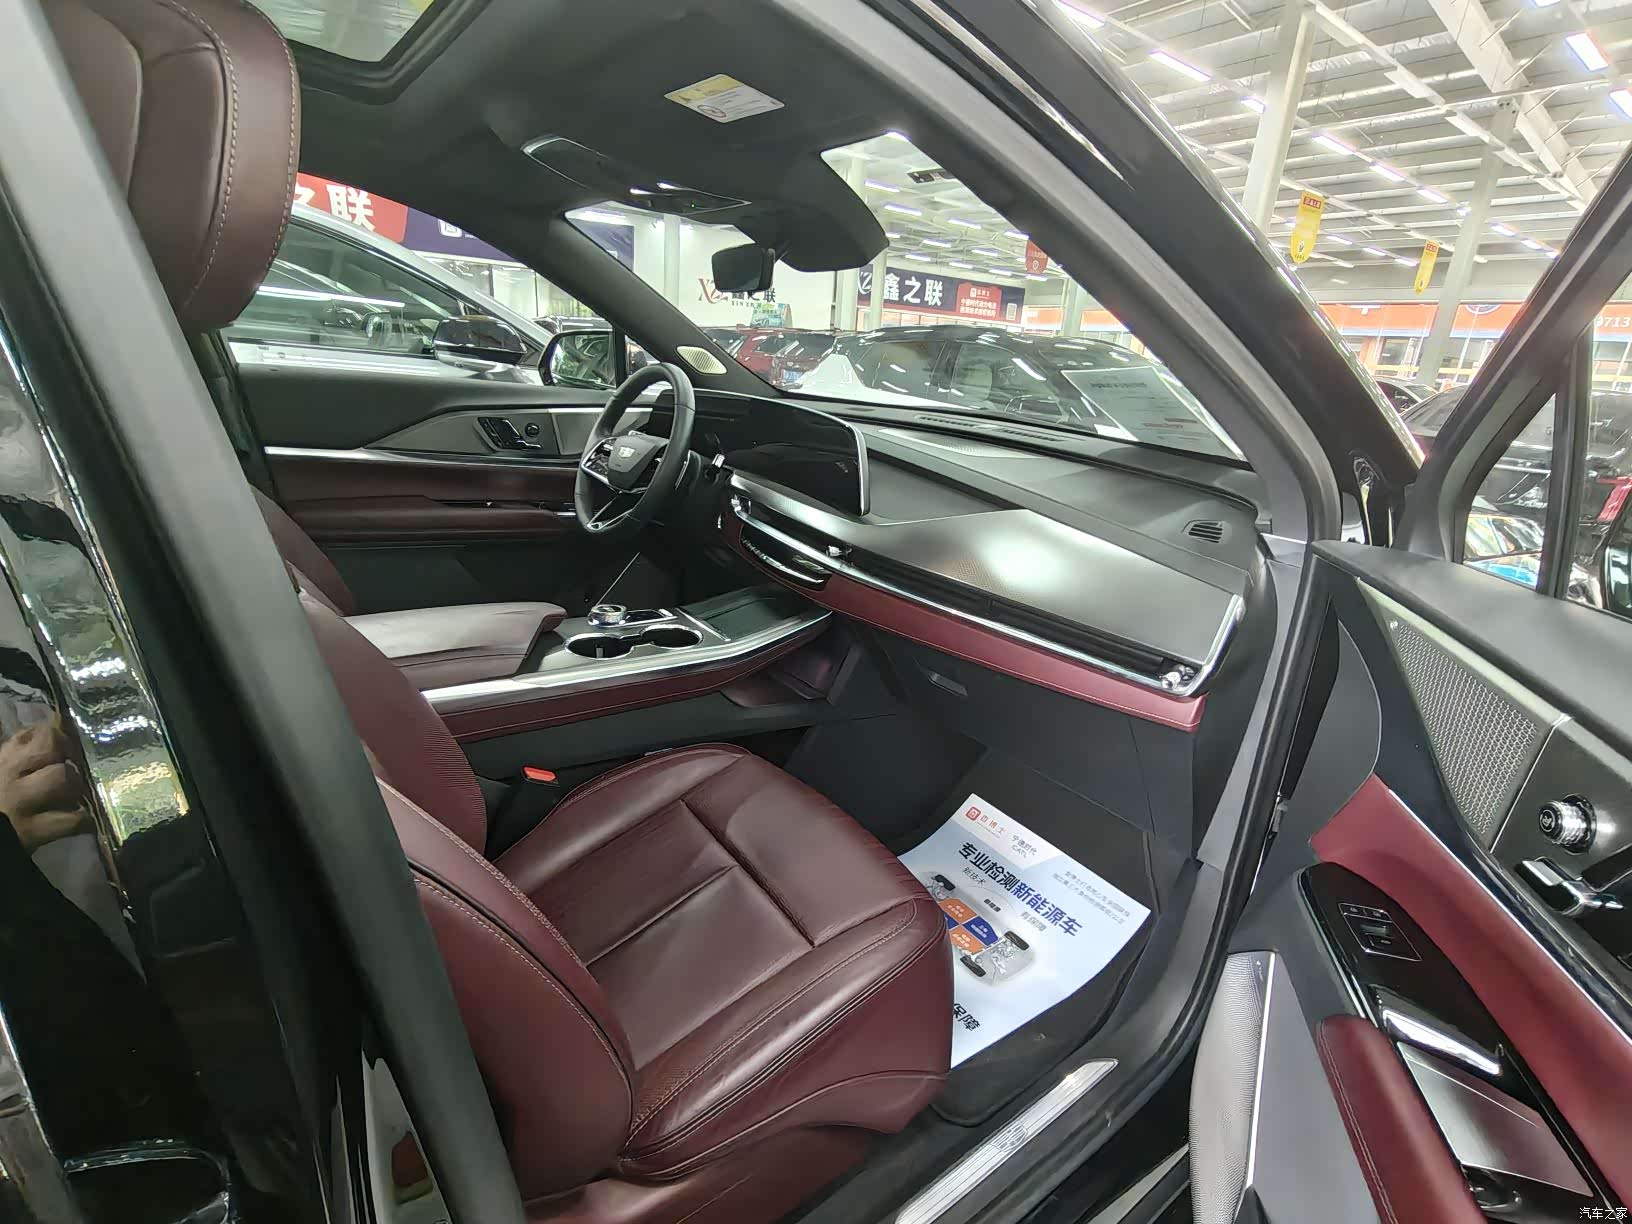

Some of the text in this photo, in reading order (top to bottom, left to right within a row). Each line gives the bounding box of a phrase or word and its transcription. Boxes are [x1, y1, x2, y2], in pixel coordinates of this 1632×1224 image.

[883, 273, 943, 306] 鑫之联
[959, 842, 1083, 937] 专业检测新能源车
